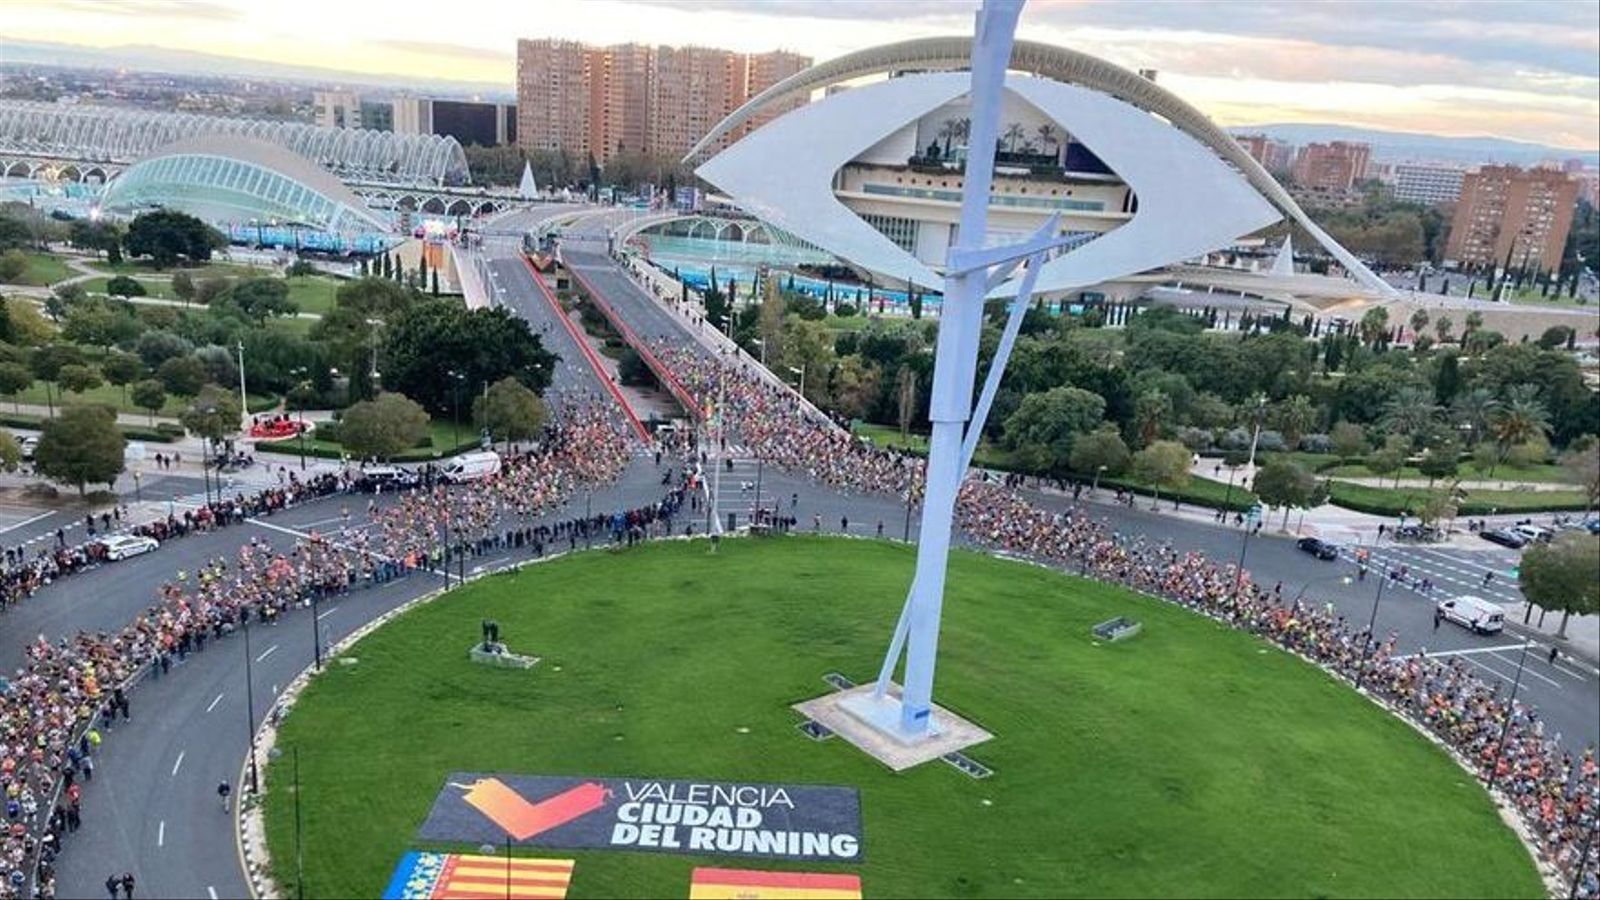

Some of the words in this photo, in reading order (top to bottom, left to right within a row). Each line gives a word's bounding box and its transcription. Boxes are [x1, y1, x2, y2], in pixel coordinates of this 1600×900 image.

[624, 782, 794, 809] VALENCIA
[617, 802, 763, 828] CIUDAD
[611, 824, 682, 848] DEL
[690, 828, 859, 858] RUNNING
